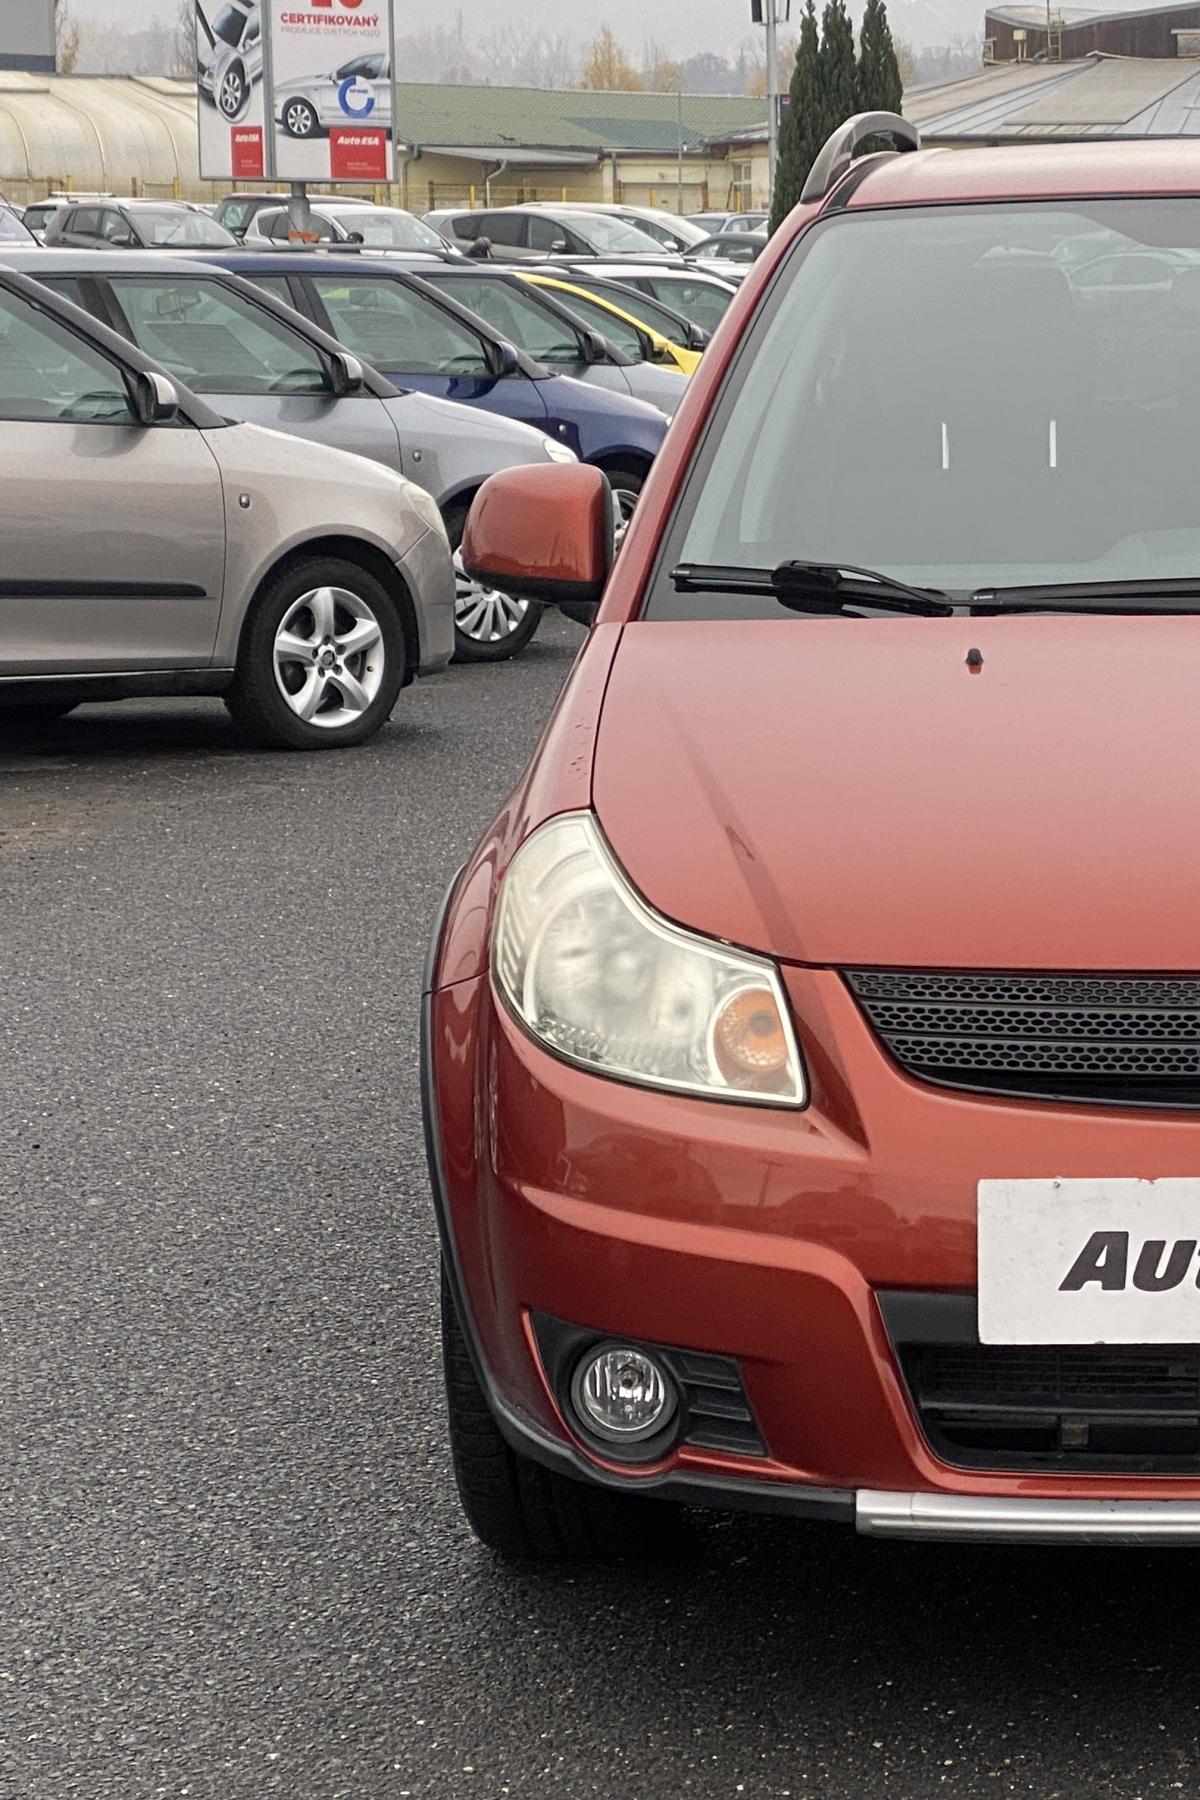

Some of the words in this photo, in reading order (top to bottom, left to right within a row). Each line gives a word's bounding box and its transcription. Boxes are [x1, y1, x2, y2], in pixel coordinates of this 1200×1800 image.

[280, 12, 379, 27] CERTIFIKOVANÝ
[337, 135, 361, 145] Auto
[361, 136, 379, 146] ESA
